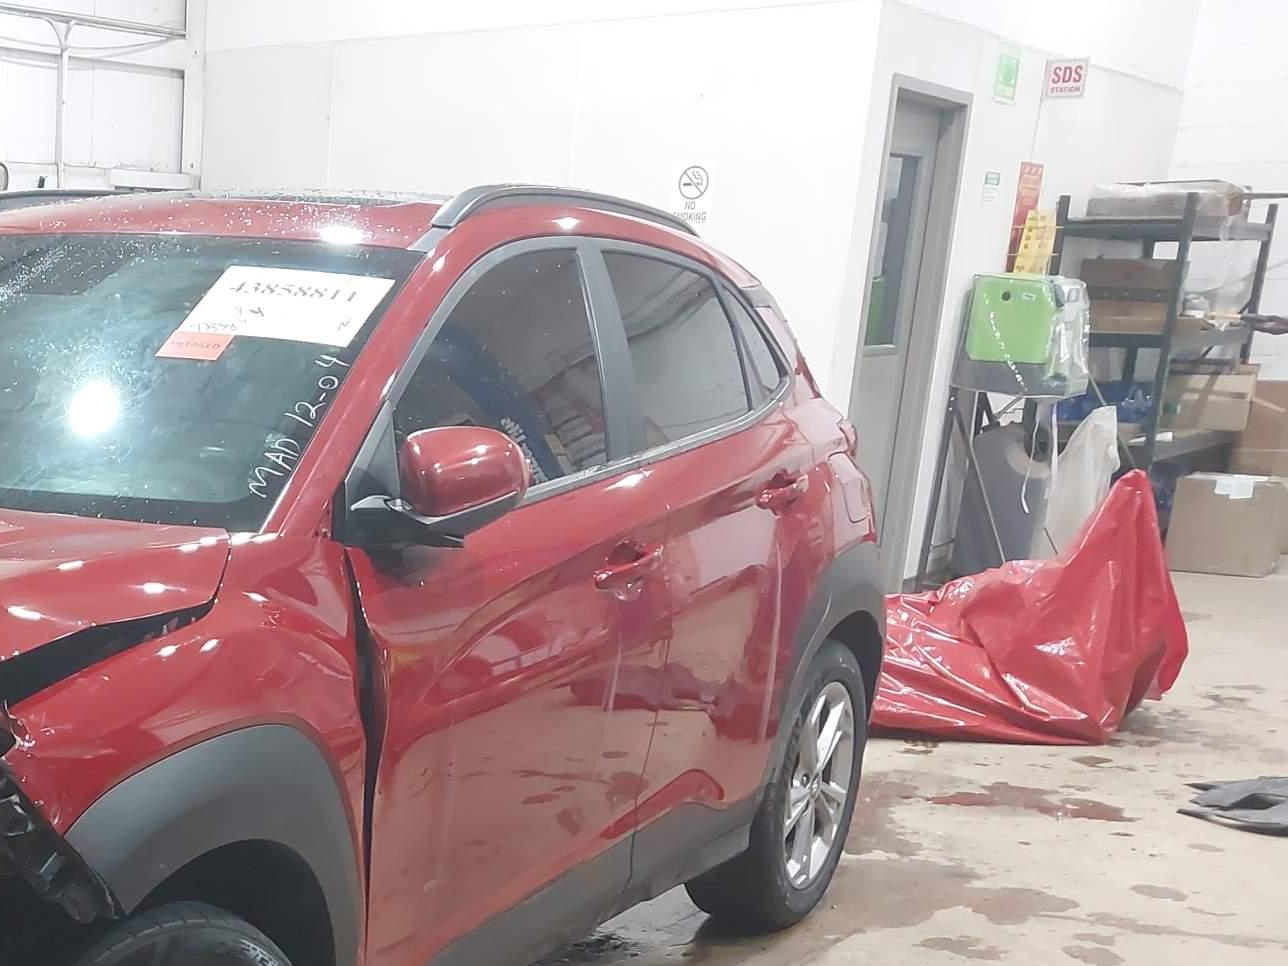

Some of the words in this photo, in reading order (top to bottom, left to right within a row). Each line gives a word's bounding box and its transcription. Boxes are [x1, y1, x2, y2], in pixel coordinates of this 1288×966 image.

[1051, 64, 1083, 84] SDS
[1050, 85, 1080, 94] STATION
[684, 200, 696, 210] NO
[229, 280, 358, 303] 43858811
[248, 437, 301, 499] MAD
[283, 354, 351, 428] 12-04
